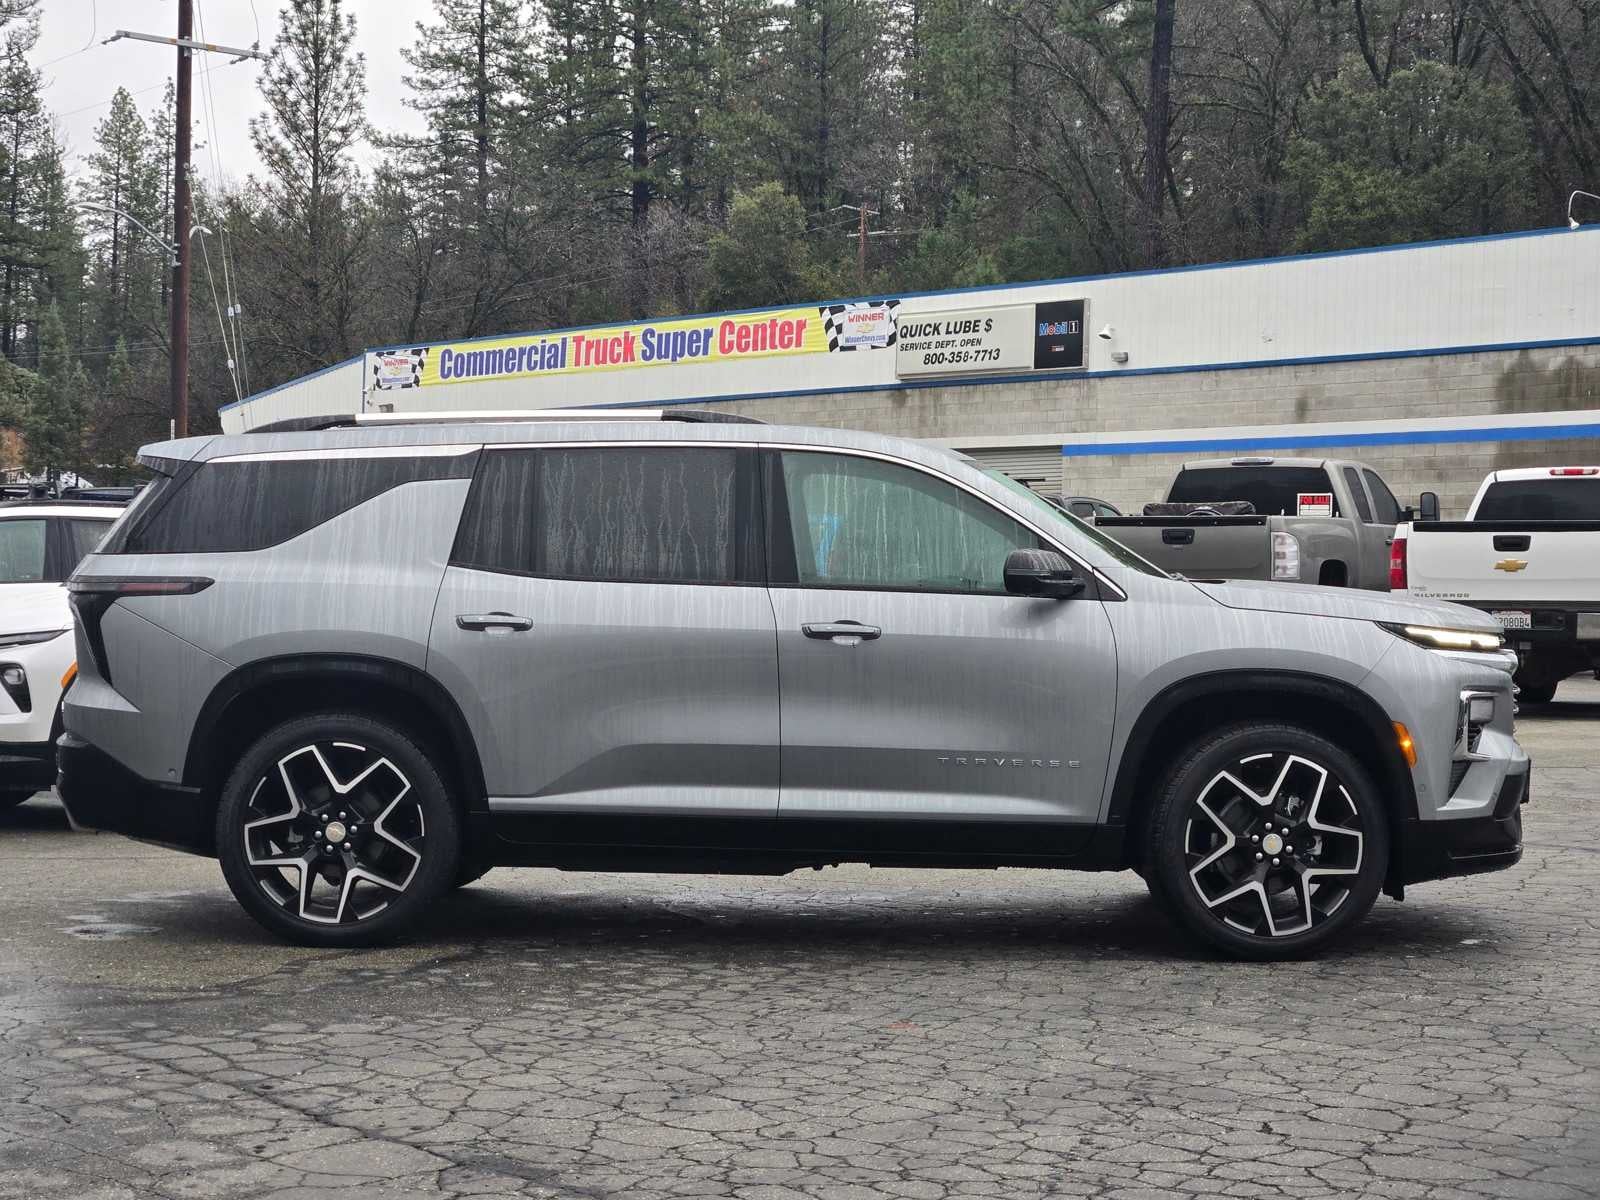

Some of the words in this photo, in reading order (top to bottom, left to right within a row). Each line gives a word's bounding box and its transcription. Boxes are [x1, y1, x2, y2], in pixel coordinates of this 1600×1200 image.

[848, 312, 885, 323] WINNER
[900, 321, 941, 339] QUICK
[945, 319, 982, 335] LUBE
[984, 318, 993, 334] $
[1039, 322, 1067, 336] Mobil
[1069, 320, 1079, 334] 1
[439, 336, 568, 380] Commercial
[572, 330, 636, 368] Truck
[641, 327, 714, 362] Super
[718, 317, 808, 355] Center
[900, 341, 932, 351] SERVICE
[935, 339, 958, 350] DEPT.
[960, 338, 982, 348] OPEN
[1301, 496, 1313, 504] FOR
[1314, 496, 1329, 504] SALE
[937, 756, 1081, 768] TRAVERSE
